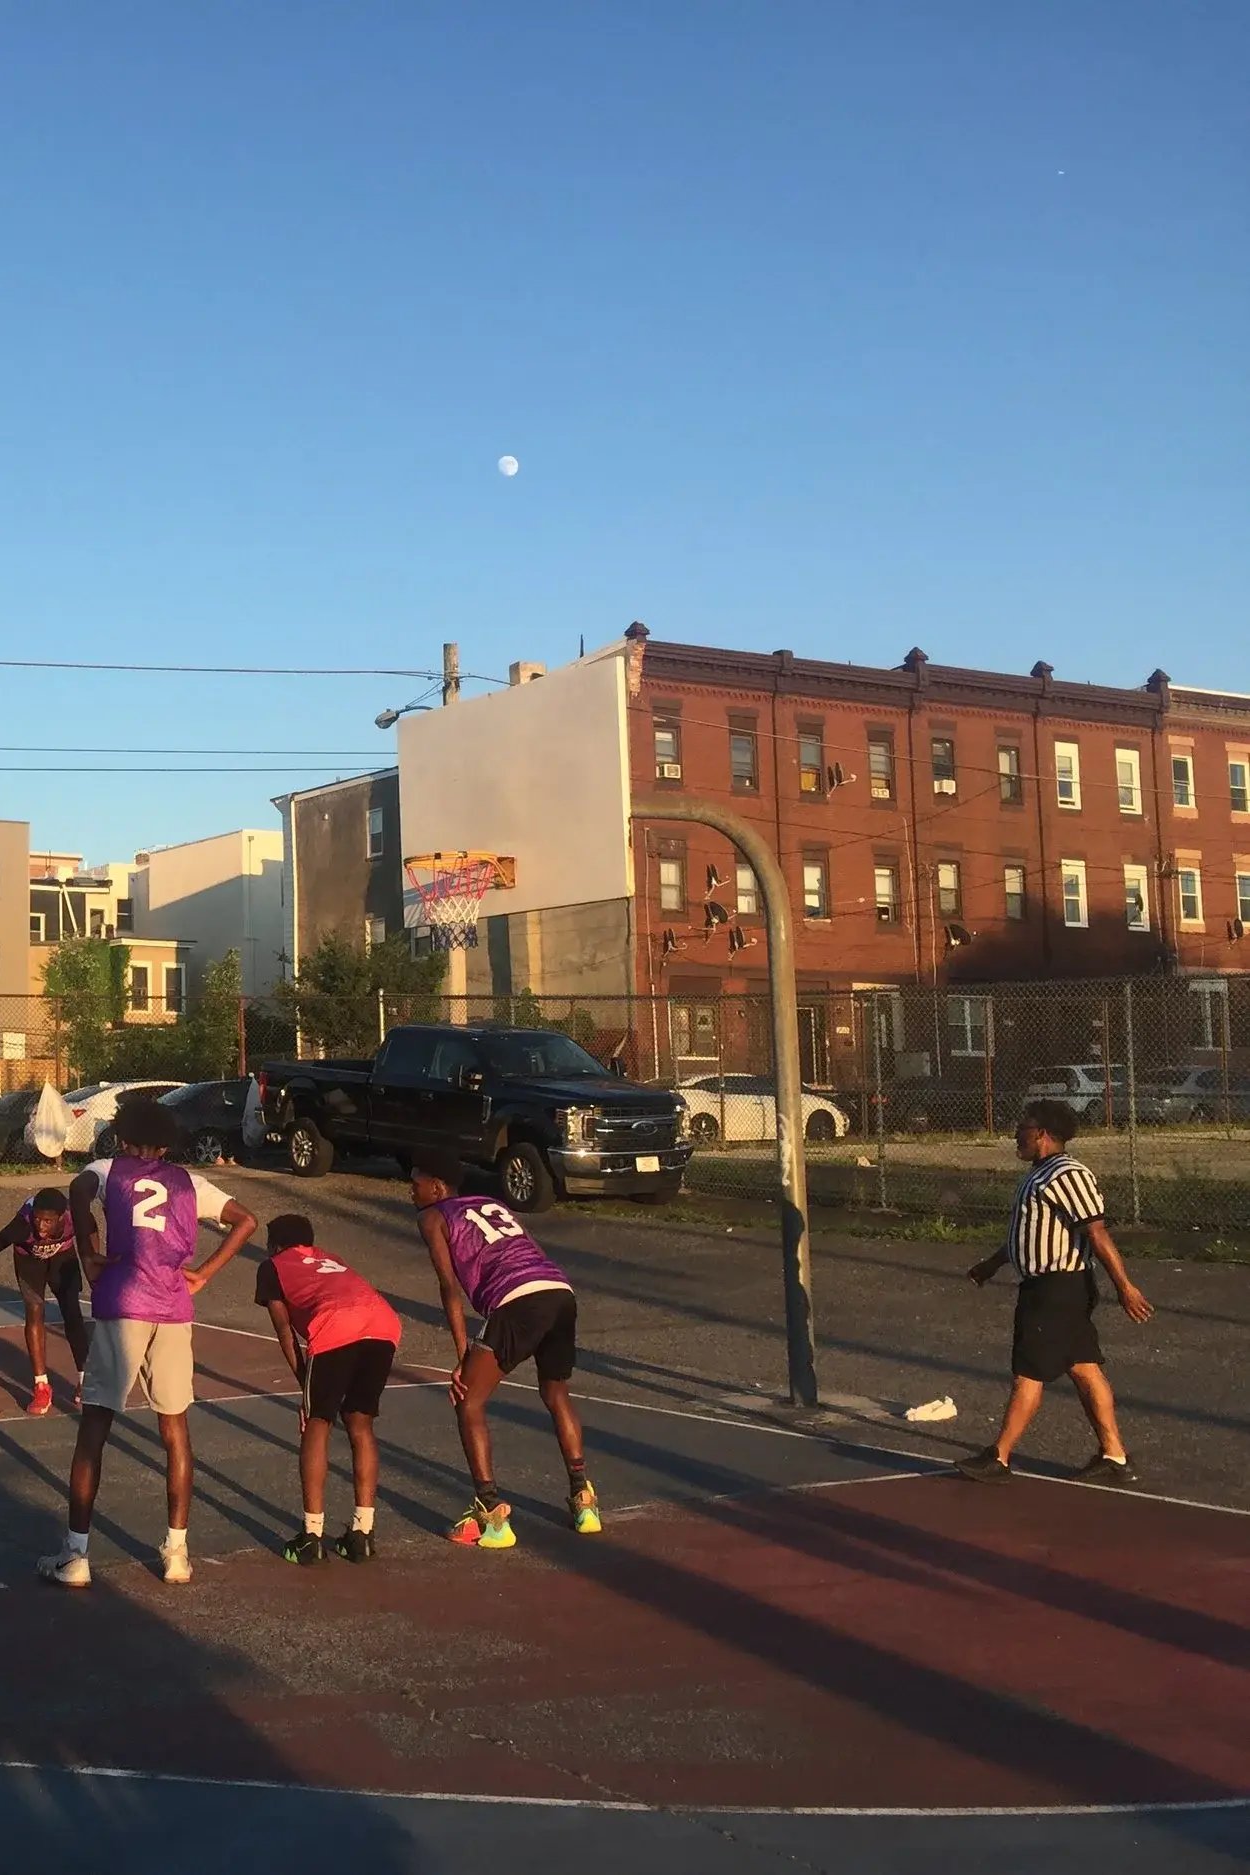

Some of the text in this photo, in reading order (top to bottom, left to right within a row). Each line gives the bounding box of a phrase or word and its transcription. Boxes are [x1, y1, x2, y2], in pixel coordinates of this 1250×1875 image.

[132, 1178, 168, 1232] 2
[465, 1203, 524, 1244] 13
[302, 1257, 348, 1273] 3
